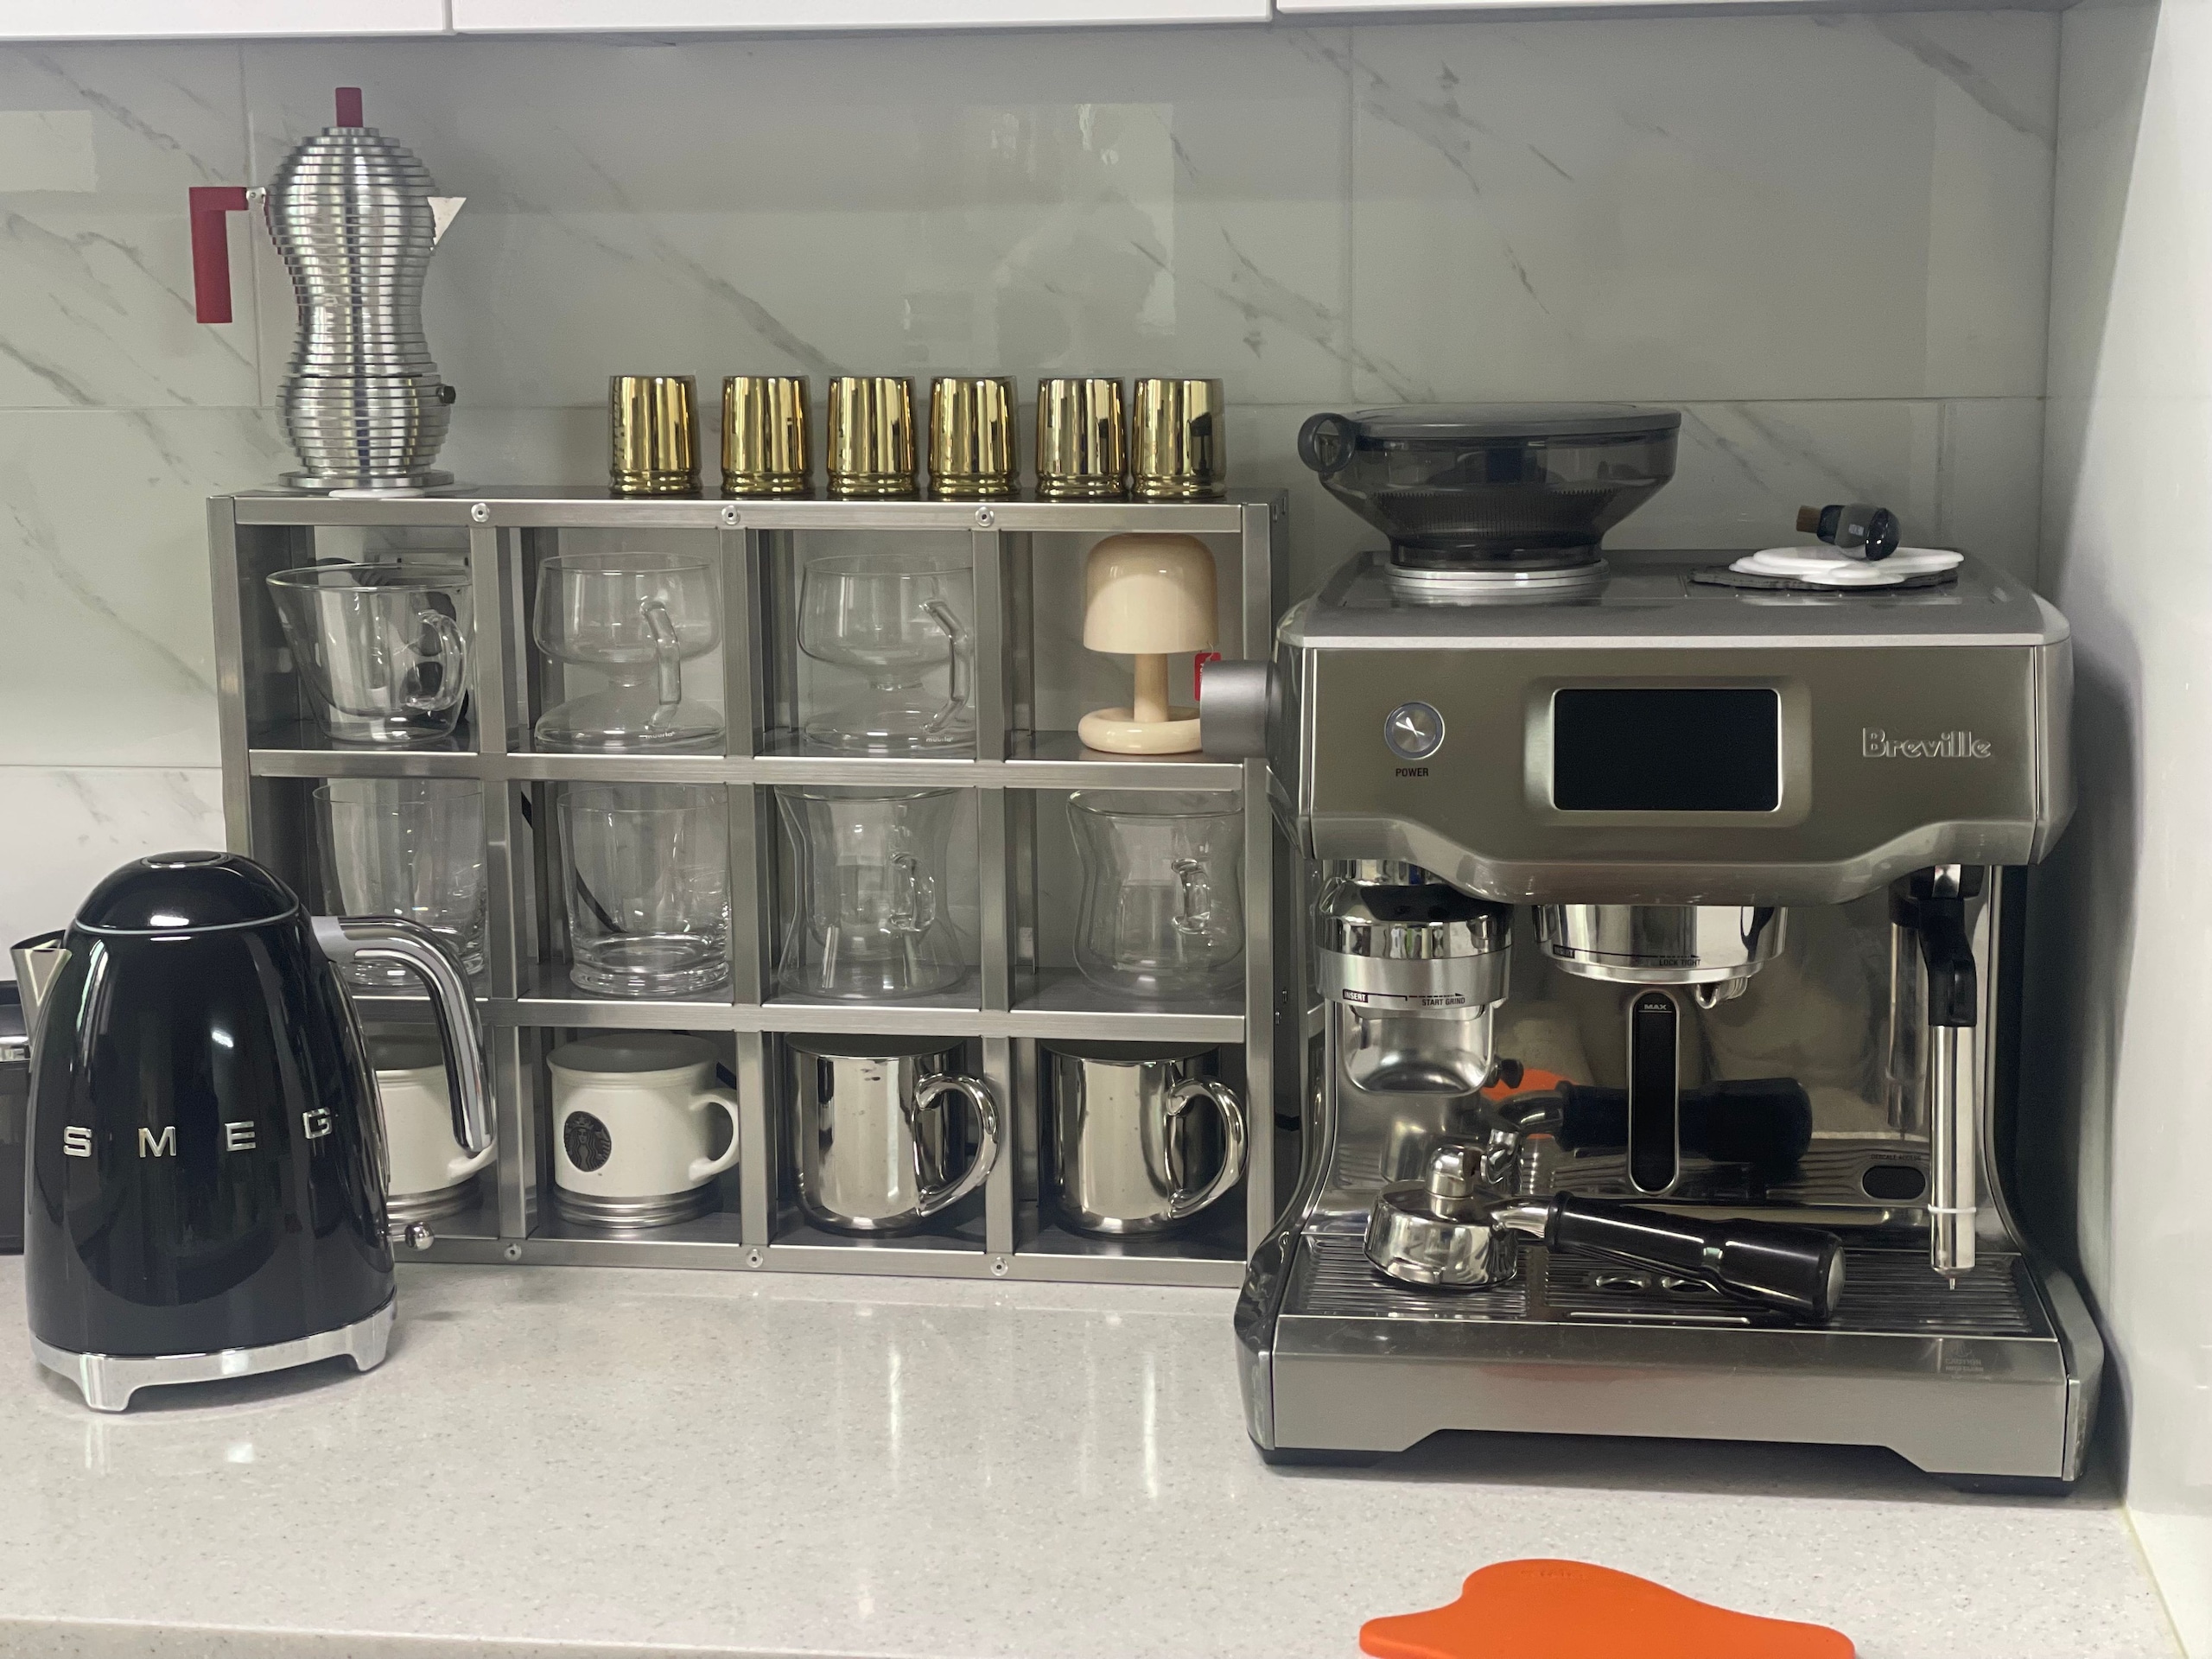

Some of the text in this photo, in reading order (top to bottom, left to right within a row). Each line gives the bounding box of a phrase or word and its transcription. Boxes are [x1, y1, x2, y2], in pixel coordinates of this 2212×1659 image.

[1863, 727, 1991, 758] Breville
[1395, 767, 1428, 777] POWER
[1344, 990, 1365, 1001] INSERT
